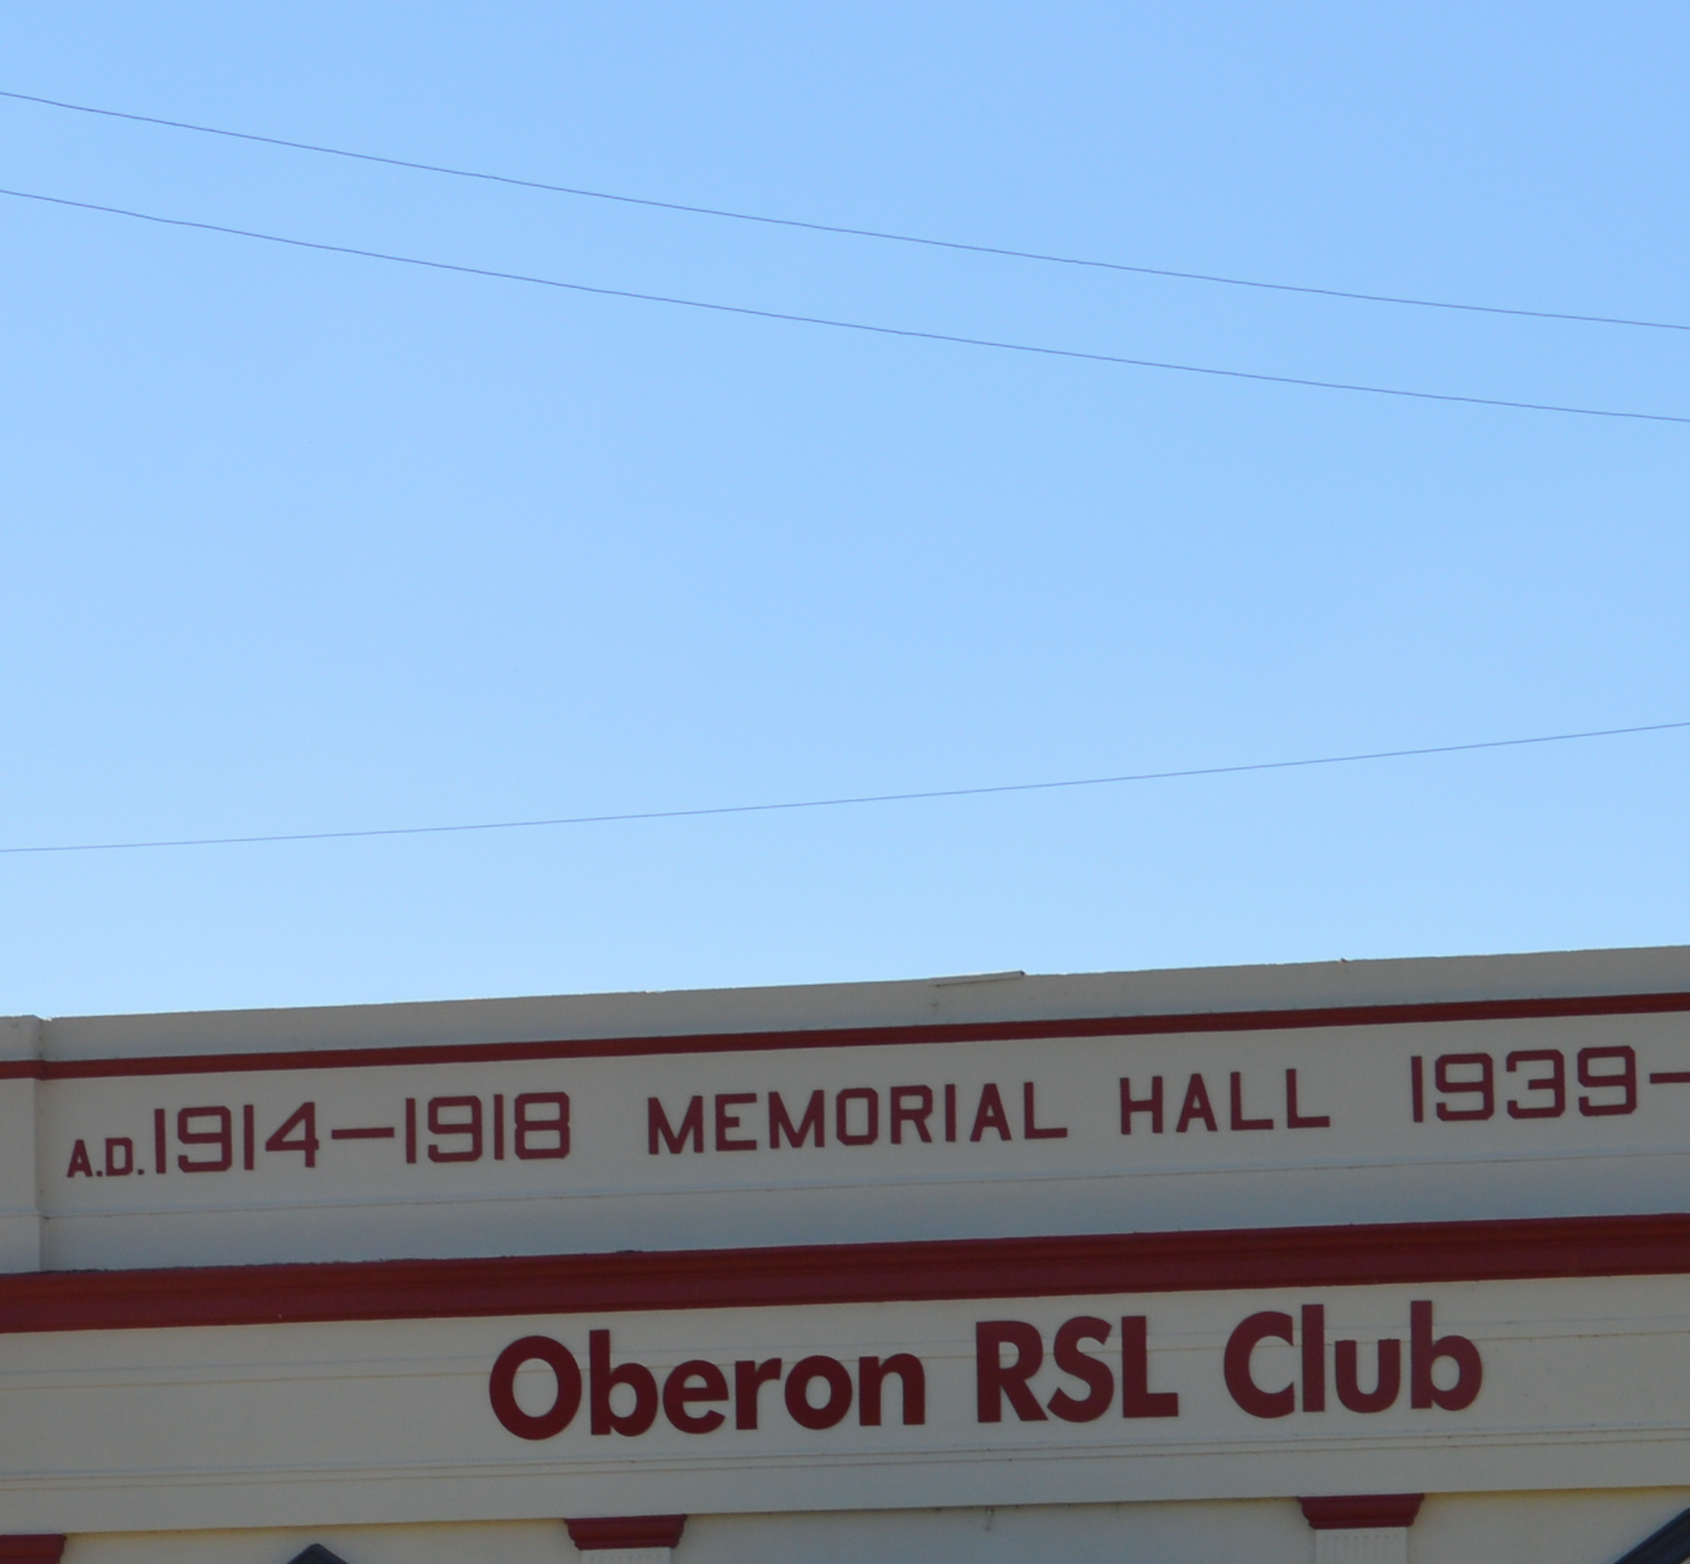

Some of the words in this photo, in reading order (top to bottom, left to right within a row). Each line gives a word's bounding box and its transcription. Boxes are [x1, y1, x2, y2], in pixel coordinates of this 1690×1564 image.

[649, 1082, 1069, 1155] MEMORIAL
[1121, 1068, 1332, 1136] HALL
[489, 1328, 927, 1441] Oberon
[975, 1316, 1180, 1424] RSL
[1223, 1300, 1483, 1418] Club
